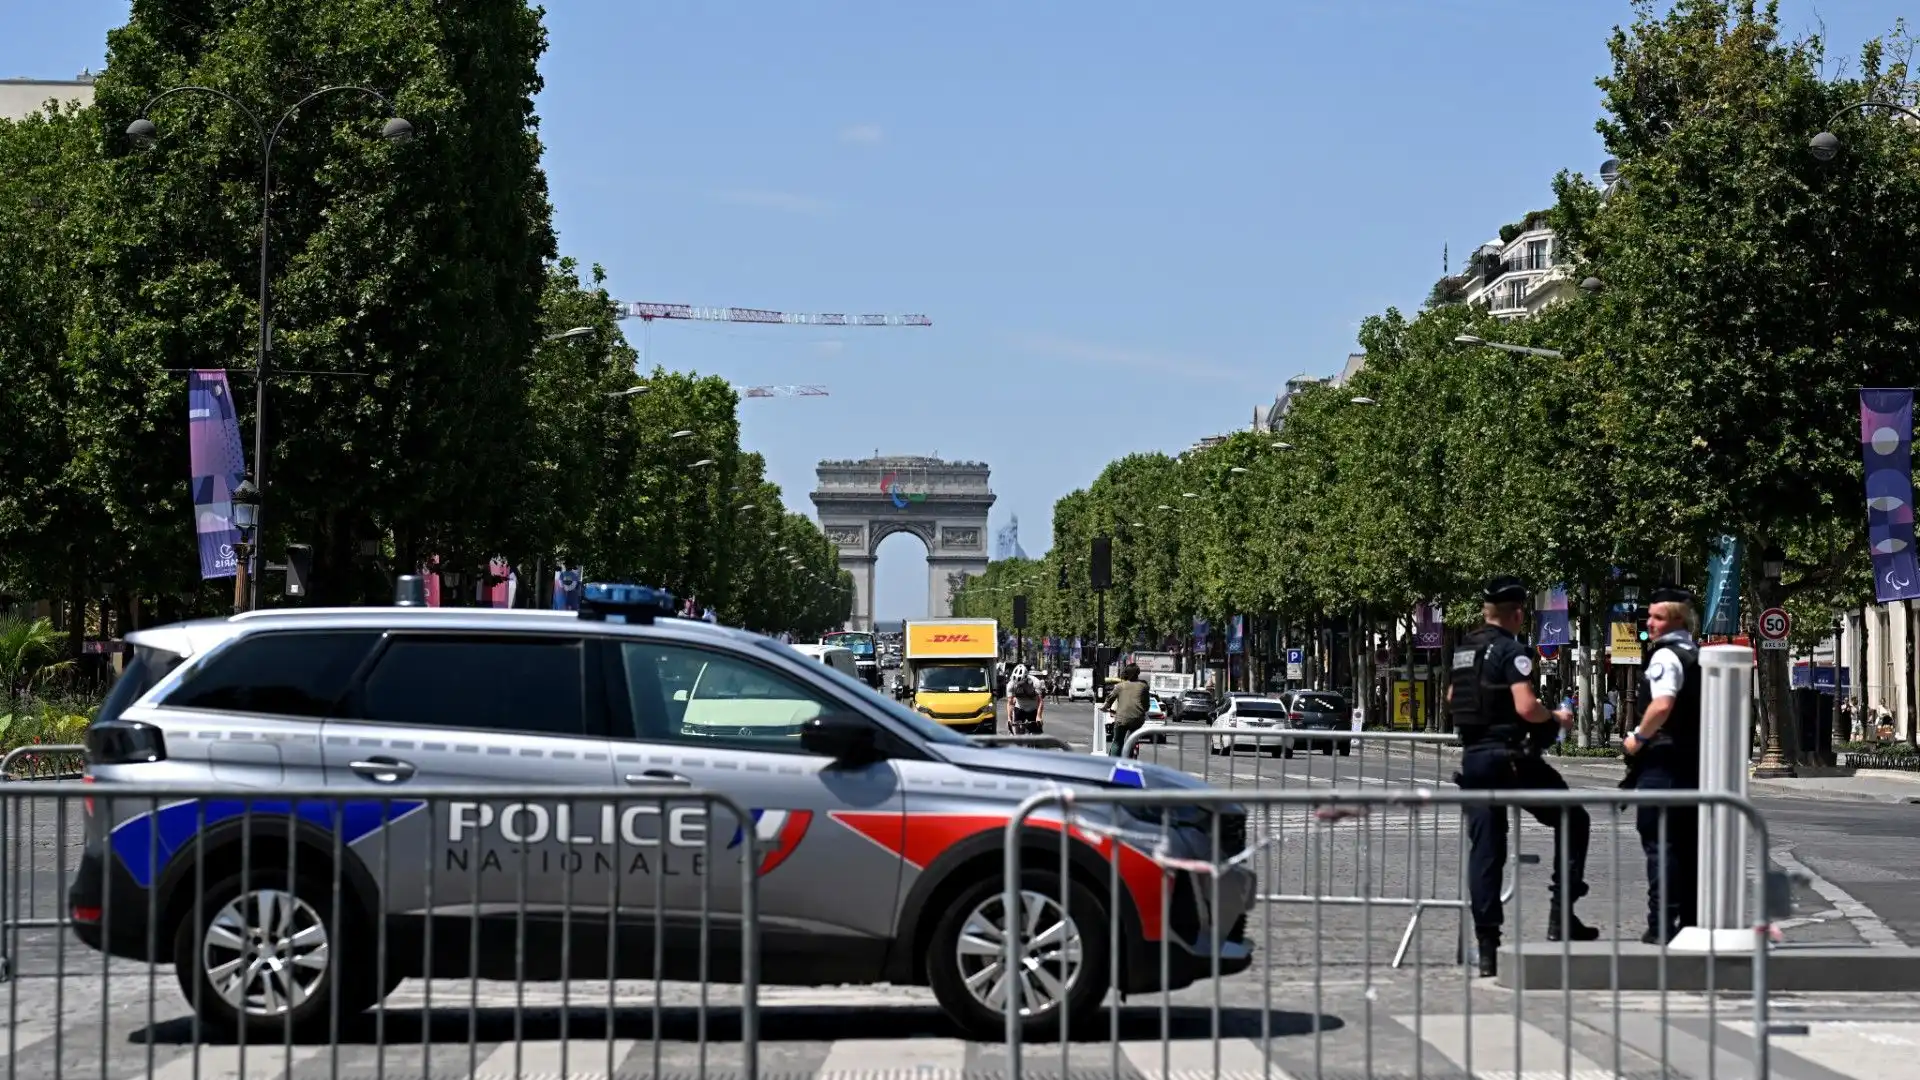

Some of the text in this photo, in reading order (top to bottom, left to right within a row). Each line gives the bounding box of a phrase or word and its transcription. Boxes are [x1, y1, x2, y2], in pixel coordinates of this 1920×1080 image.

[1766, 619, 1785, 632] 50
[932, 634, 970, 643] DHL
[1291, 652, 1298, 661] P
[449, 802, 707, 846] POLICE
[446, 849, 707, 876] NAIONALE
